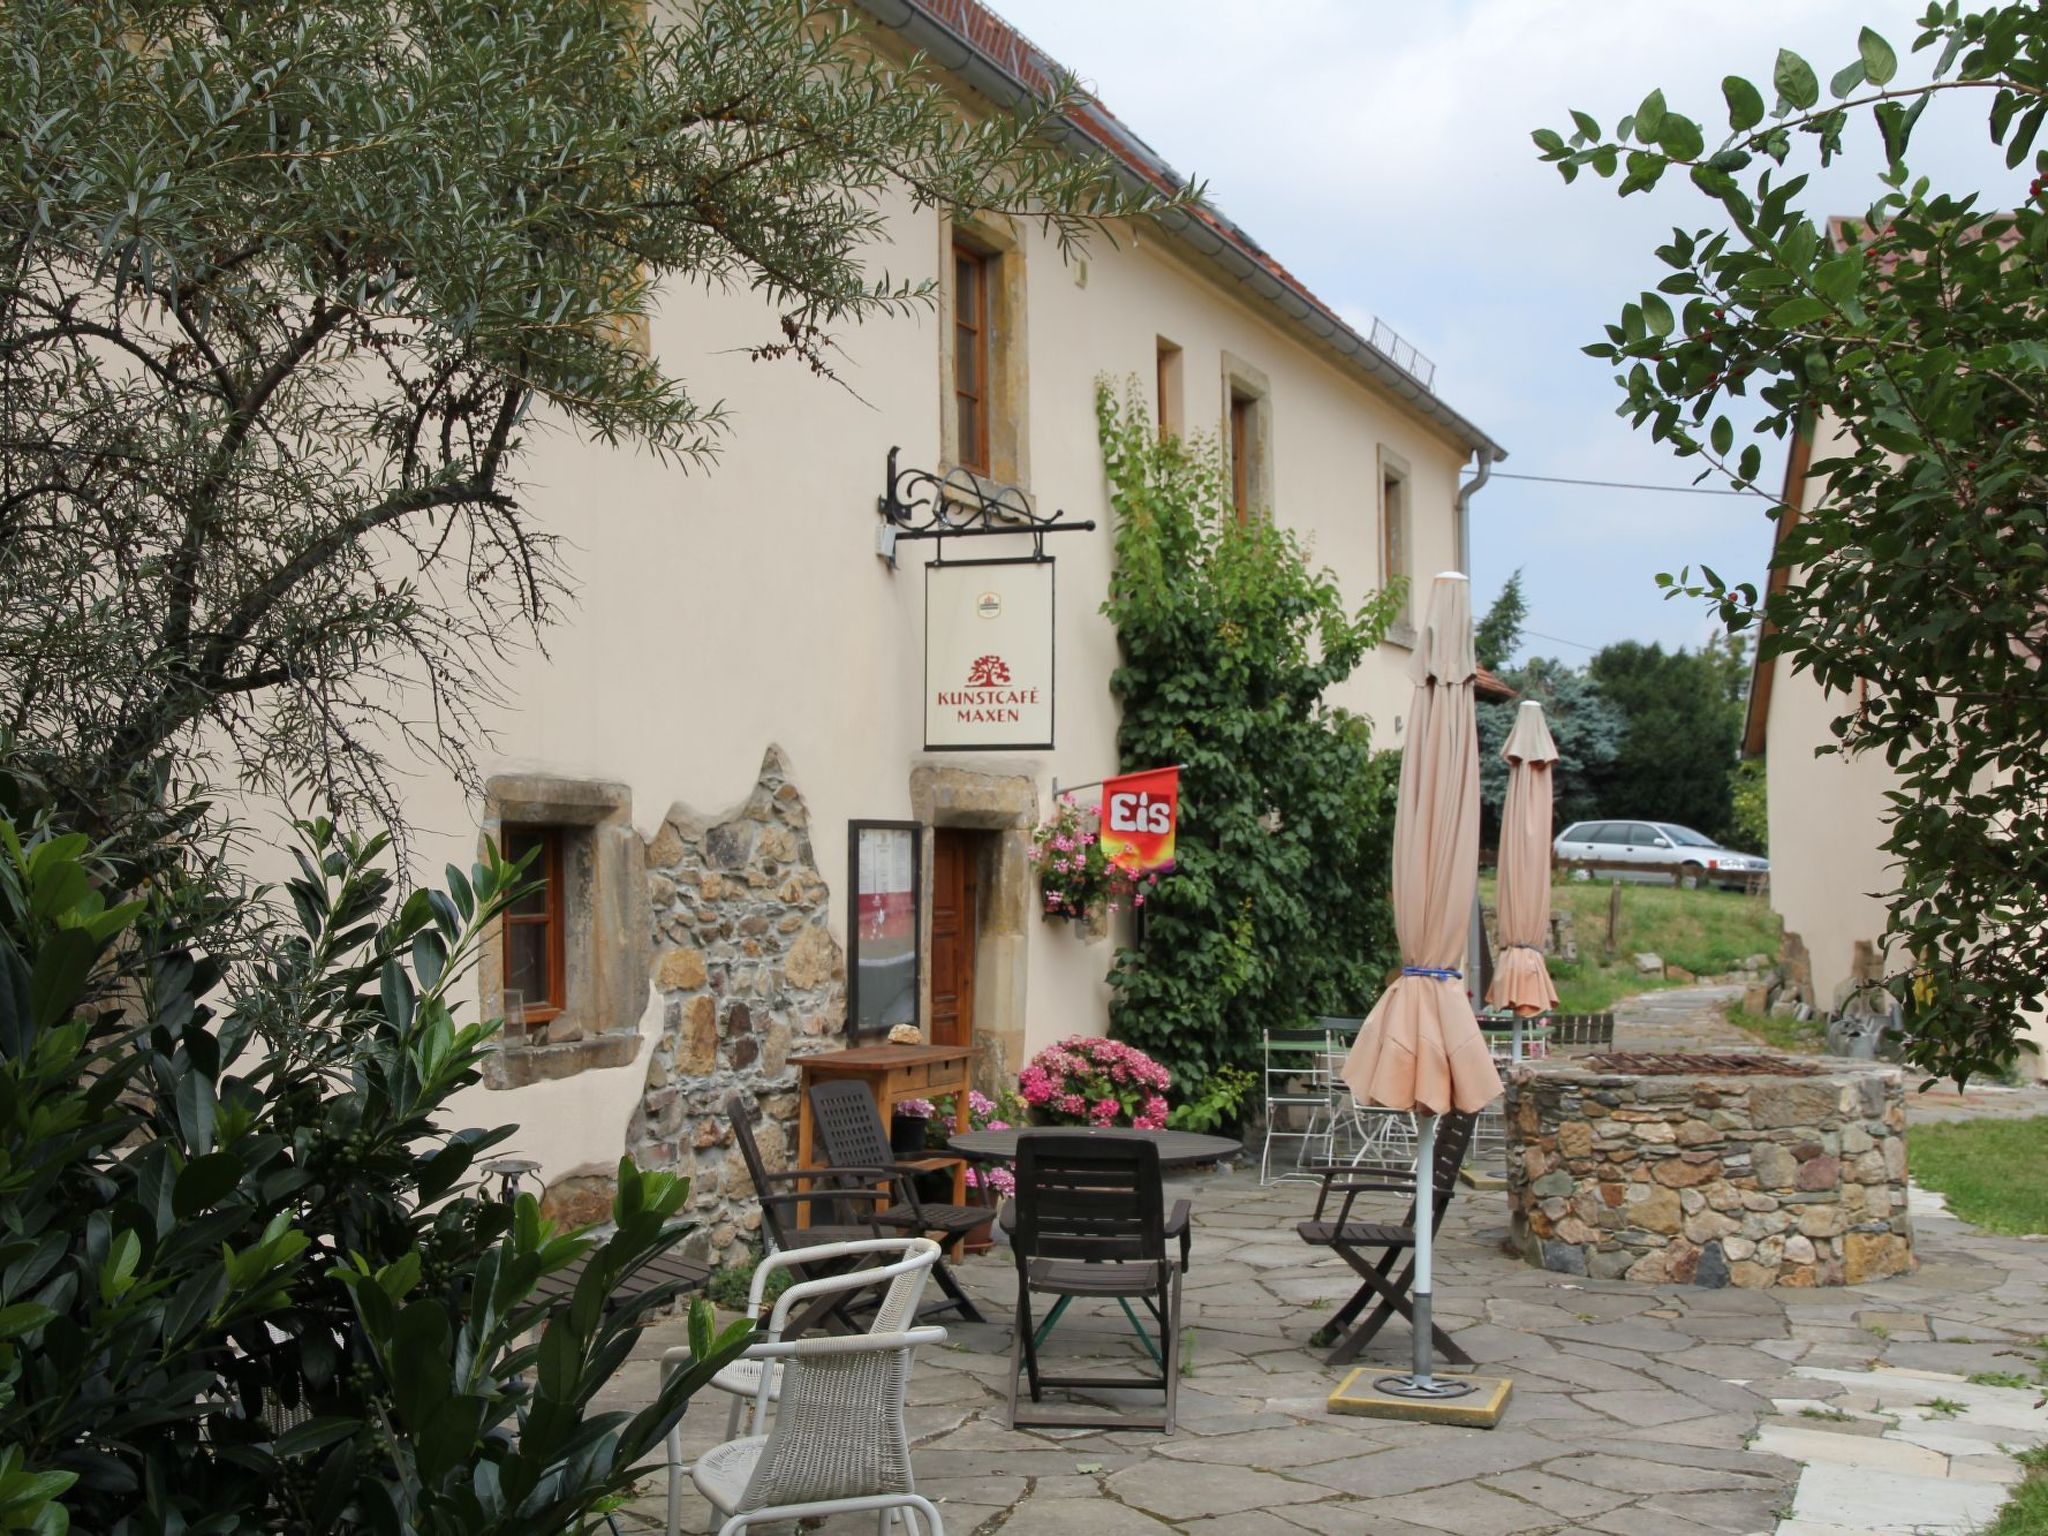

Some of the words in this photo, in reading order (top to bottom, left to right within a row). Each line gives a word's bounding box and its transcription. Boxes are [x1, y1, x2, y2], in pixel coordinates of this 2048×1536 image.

[938, 687, 1039, 705] KUNSTCAFÉ
[957, 709, 1019, 723] MAXEN
[1110, 791, 1170, 834] Eis
